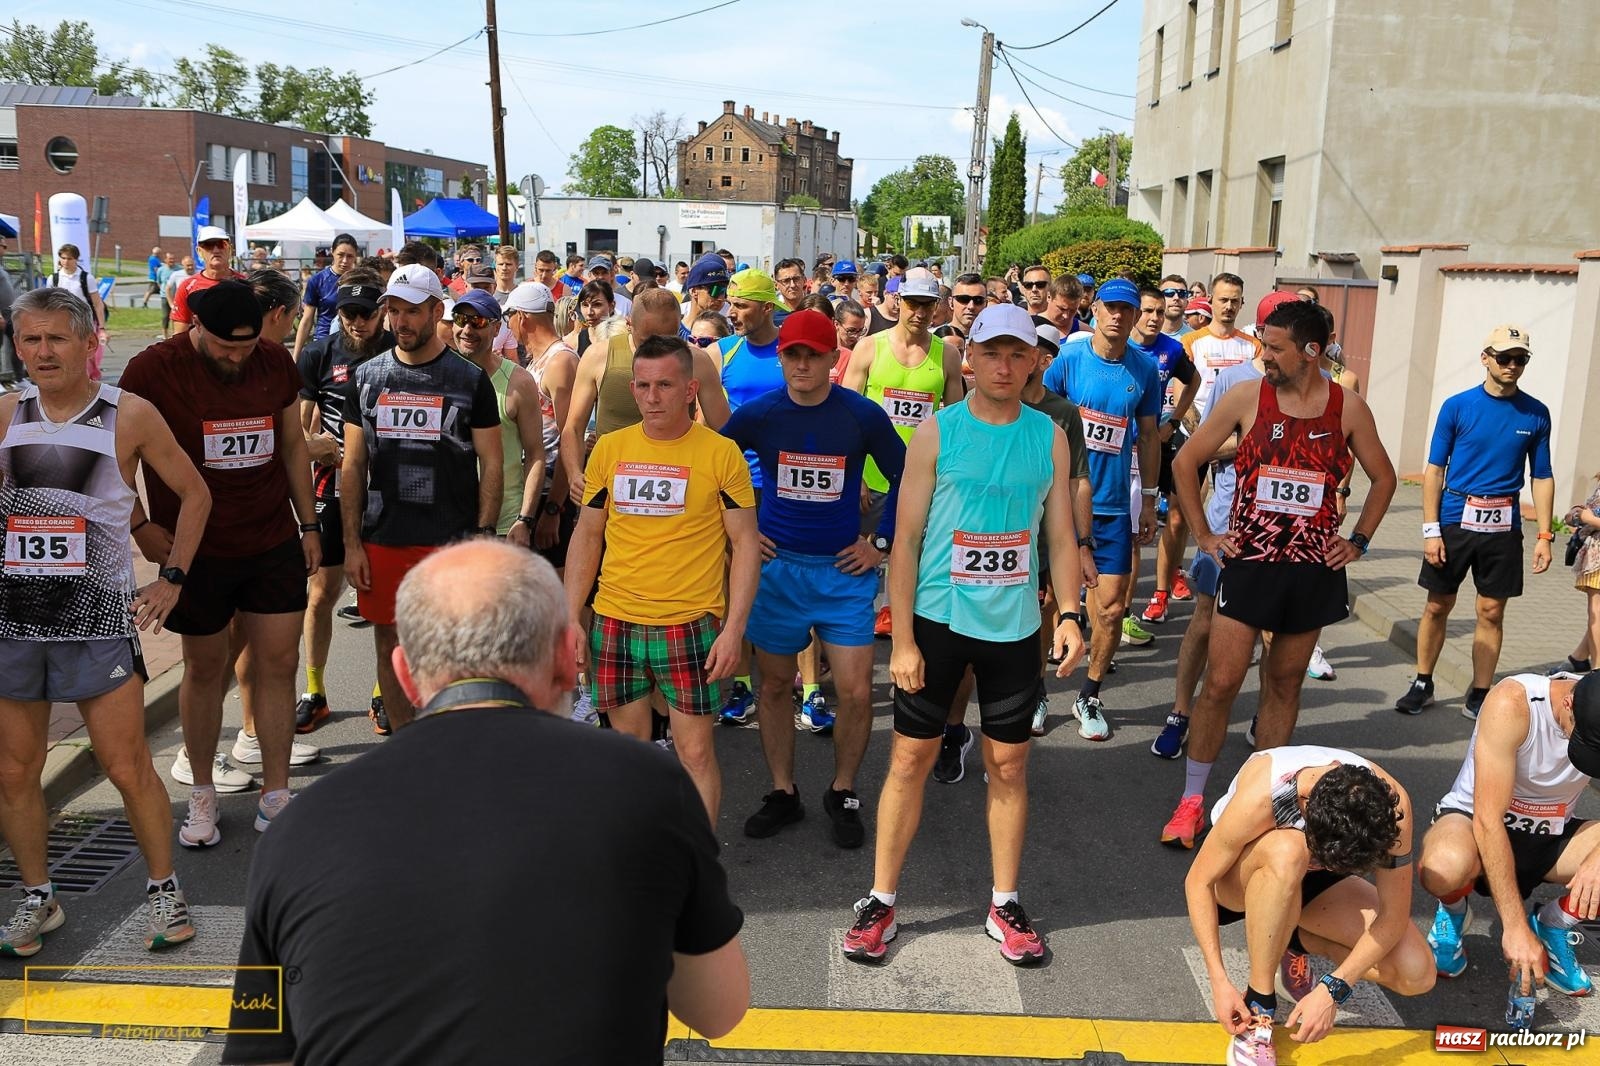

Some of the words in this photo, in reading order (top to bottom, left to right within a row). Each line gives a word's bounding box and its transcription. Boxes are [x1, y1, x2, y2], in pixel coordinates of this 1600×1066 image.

[392, 408, 428, 427] 170
[894, 400, 923, 418] 132
[1086, 422, 1114, 442] 131
[222, 434, 260, 456] 217
[628, 478, 672, 502] 143
[790, 468, 832, 490] 155
[1271, 480, 1310, 503] 138
[1475, 509, 1502, 524] 173
[18, 536, 68, 560] 135
[965, 550, 1018, 572] 238
[1504, 812, 1550, 834] 236
